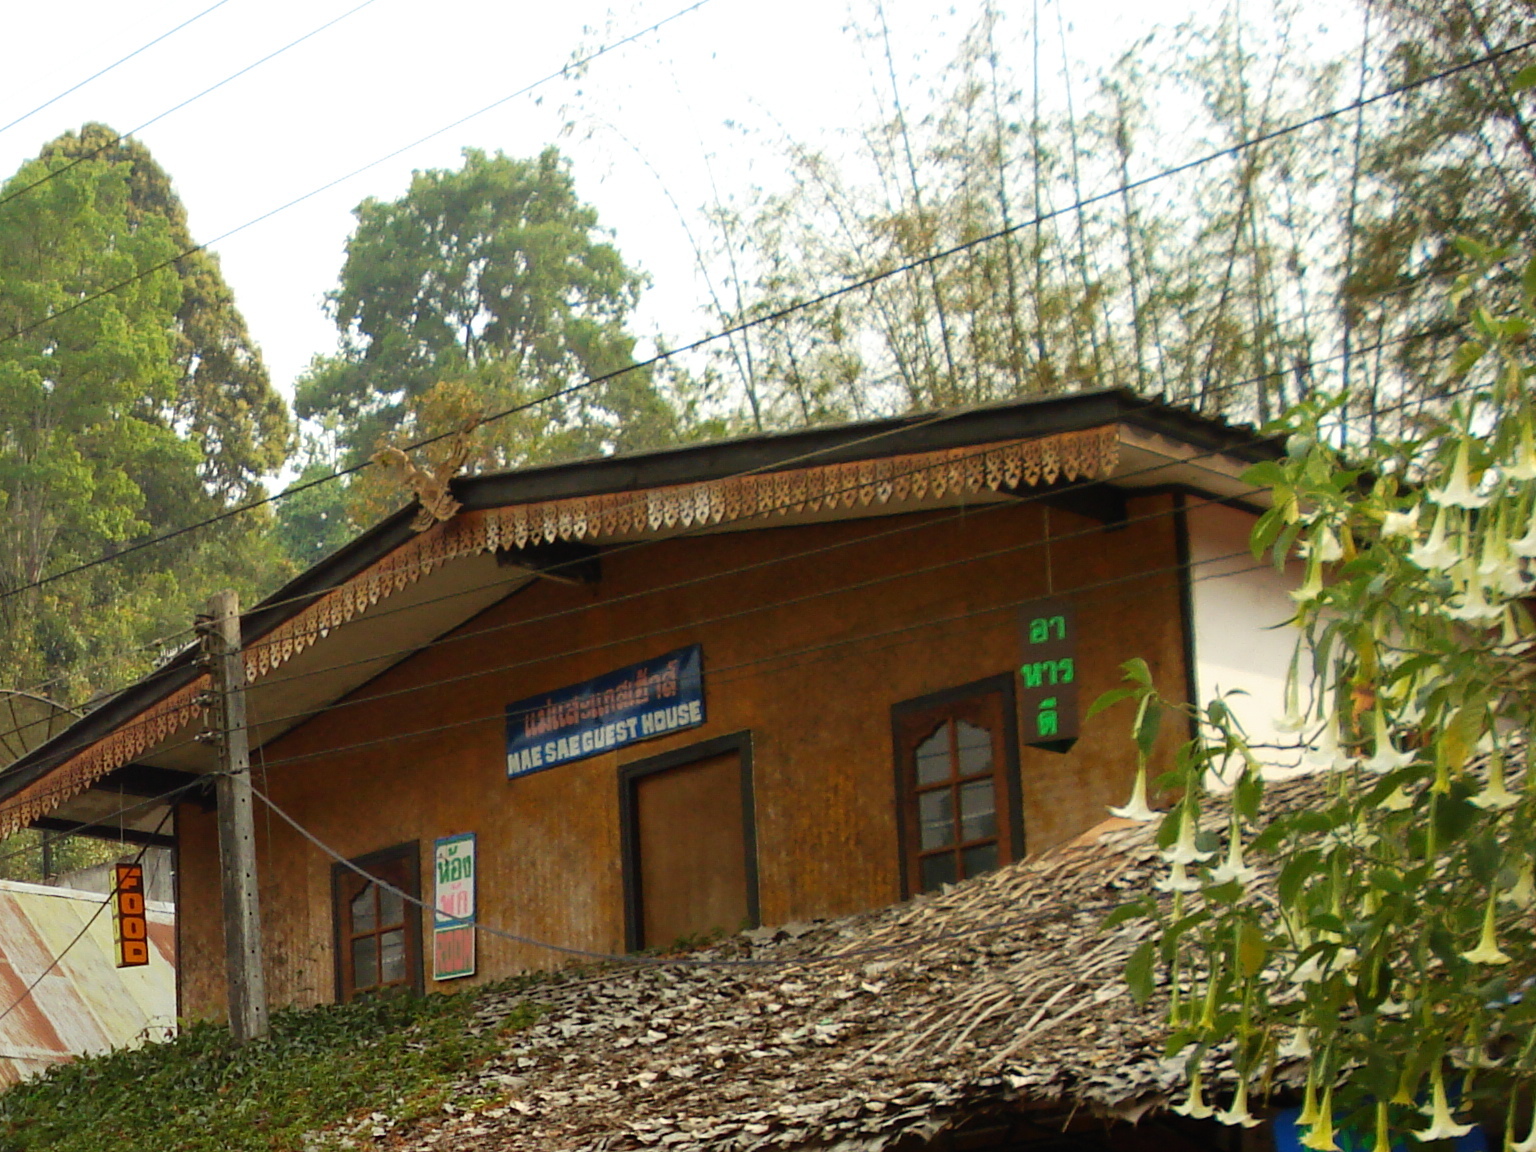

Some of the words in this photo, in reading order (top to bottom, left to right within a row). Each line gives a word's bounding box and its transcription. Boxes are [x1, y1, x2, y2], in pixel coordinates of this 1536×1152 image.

[507, 744, 543, 775] MAE
[545, 734, 581, 763] SAE
[582, 716, 639, 753] GUEST
[641, 699, 702, 735] HOUSE
[118, 867, 147, 963] FOOD
